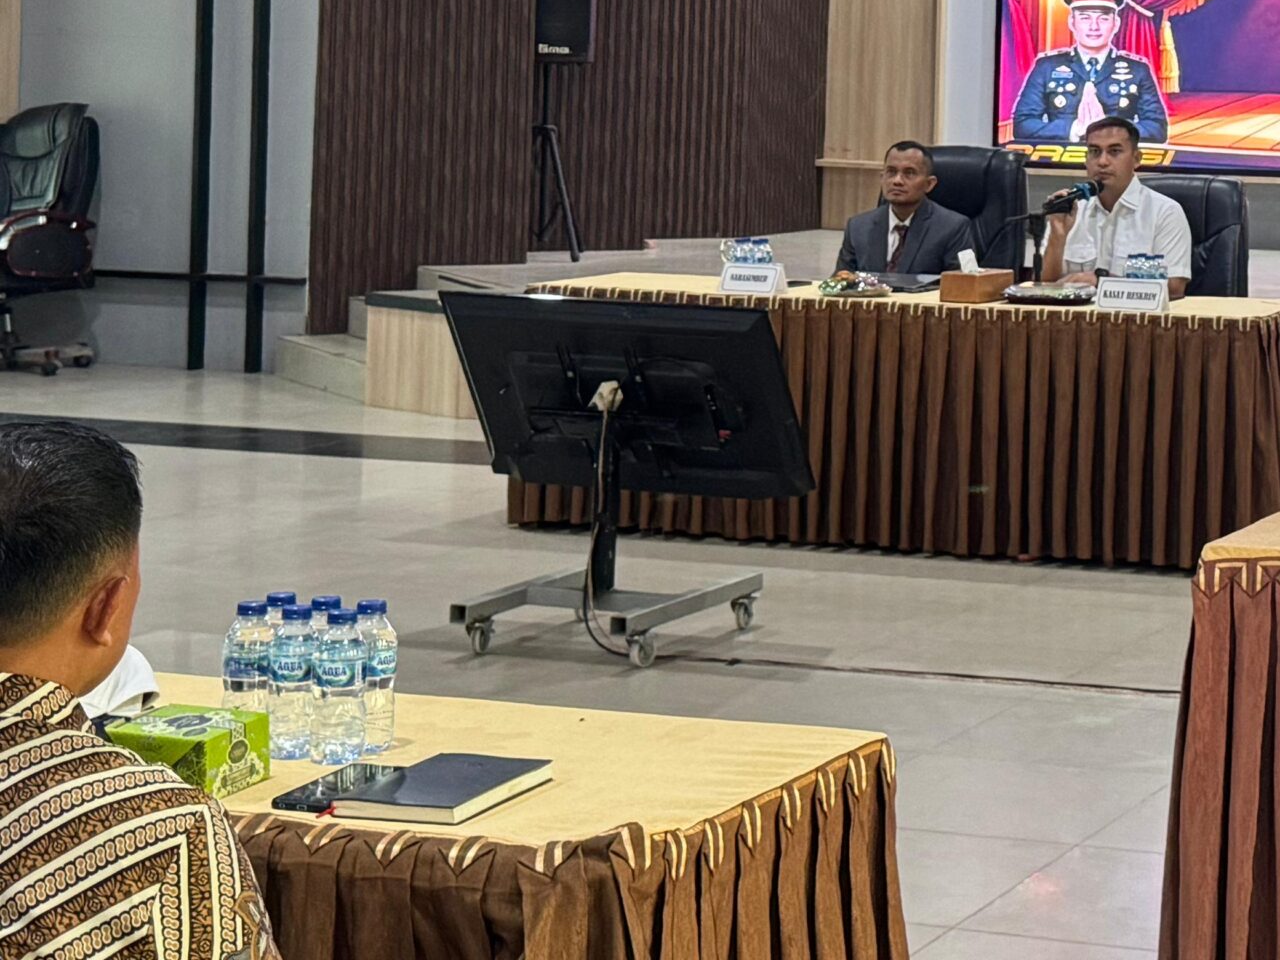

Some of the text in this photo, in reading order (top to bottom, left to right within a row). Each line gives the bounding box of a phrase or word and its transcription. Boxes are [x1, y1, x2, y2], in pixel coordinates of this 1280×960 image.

[1005, 144, 1176, 166] PRESI
[1102, 289, 1125, 299] KASAT
[277, 660, 303, 672] AQUA
[321, 666, 347, 677] AQUA
